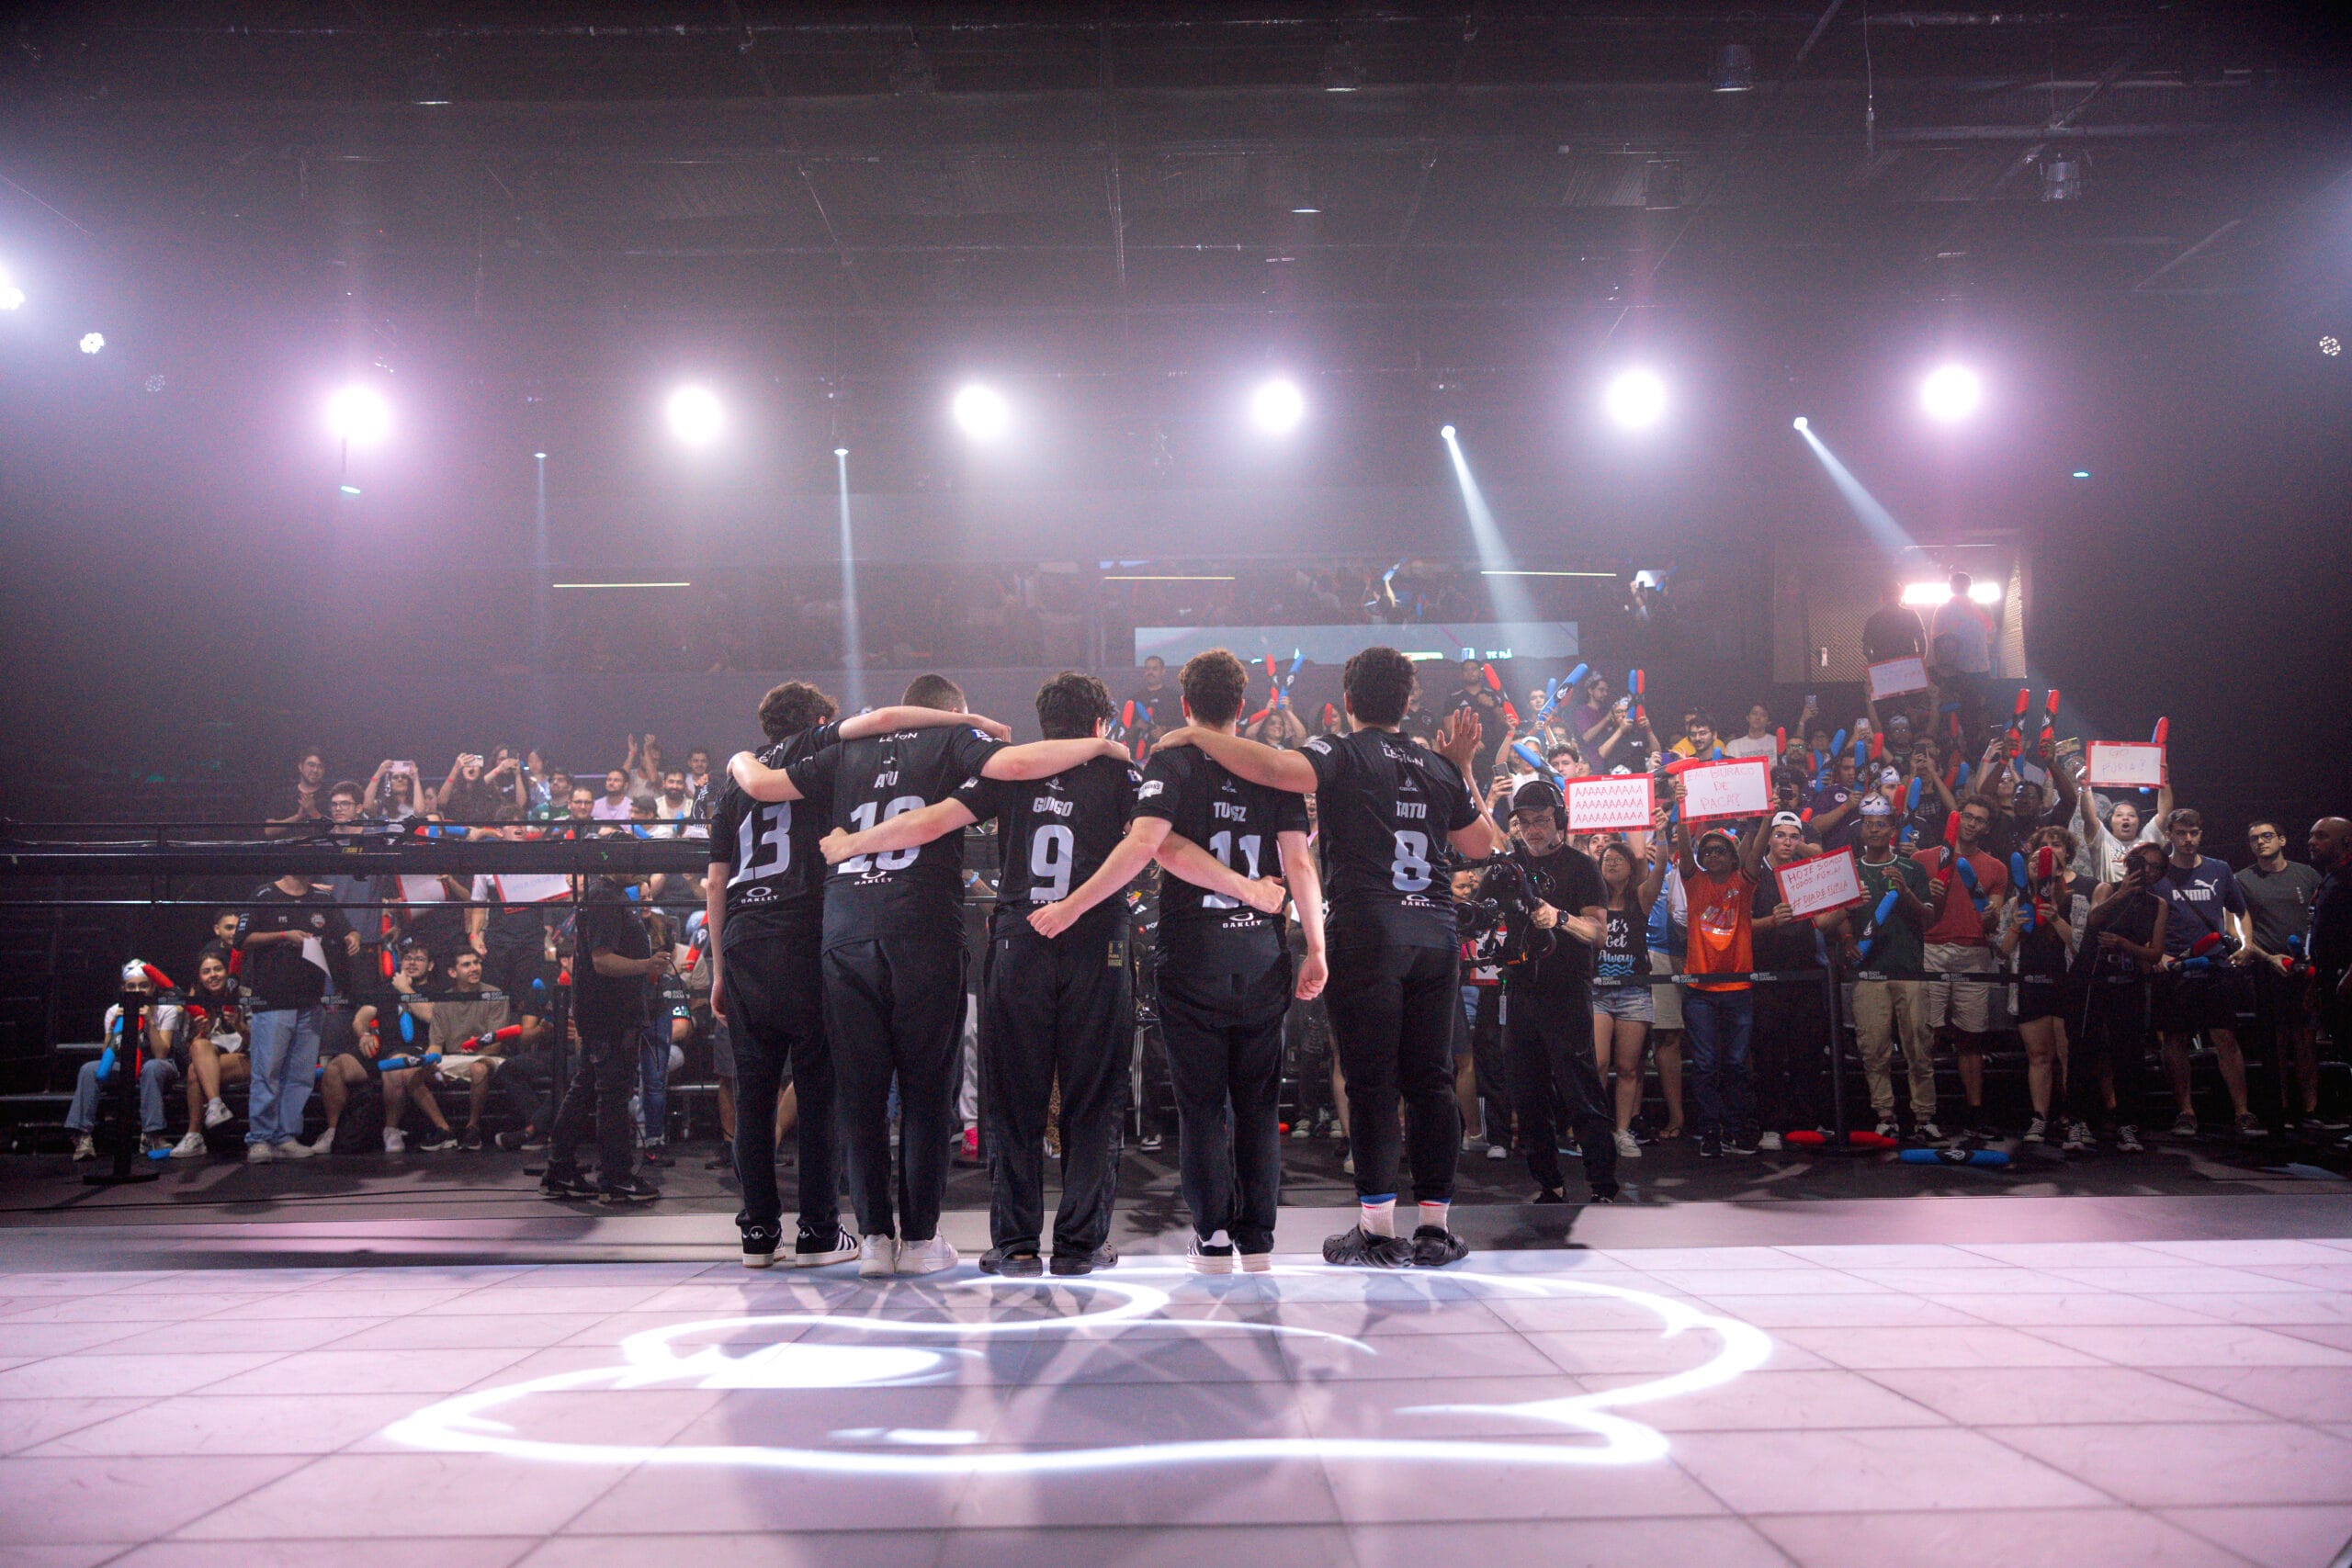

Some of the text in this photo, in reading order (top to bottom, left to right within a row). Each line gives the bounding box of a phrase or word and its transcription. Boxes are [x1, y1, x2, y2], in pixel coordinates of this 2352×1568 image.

[878, 732, 918, 743] LEION
[1032, 795, 1074, 818] GUIGO
[1396, 801, 1427, 819] TATU
[726, 801, 792, 889] 13
[1030, 824, 1074, 901] 9
[1391, 829, 1432, 892] 8
[1202, 830, 1261, 909] 11
[854, 877, 893, 886] OAKLEY
[741, 895, 778, 904] OAKLEY
[1222, 919, 1263, 929] OAKLEY
[1607, 918, 1629, 933] et's
[1605, 933, 1628, 948] Get
[1598, 950, 1636, 966] Away
